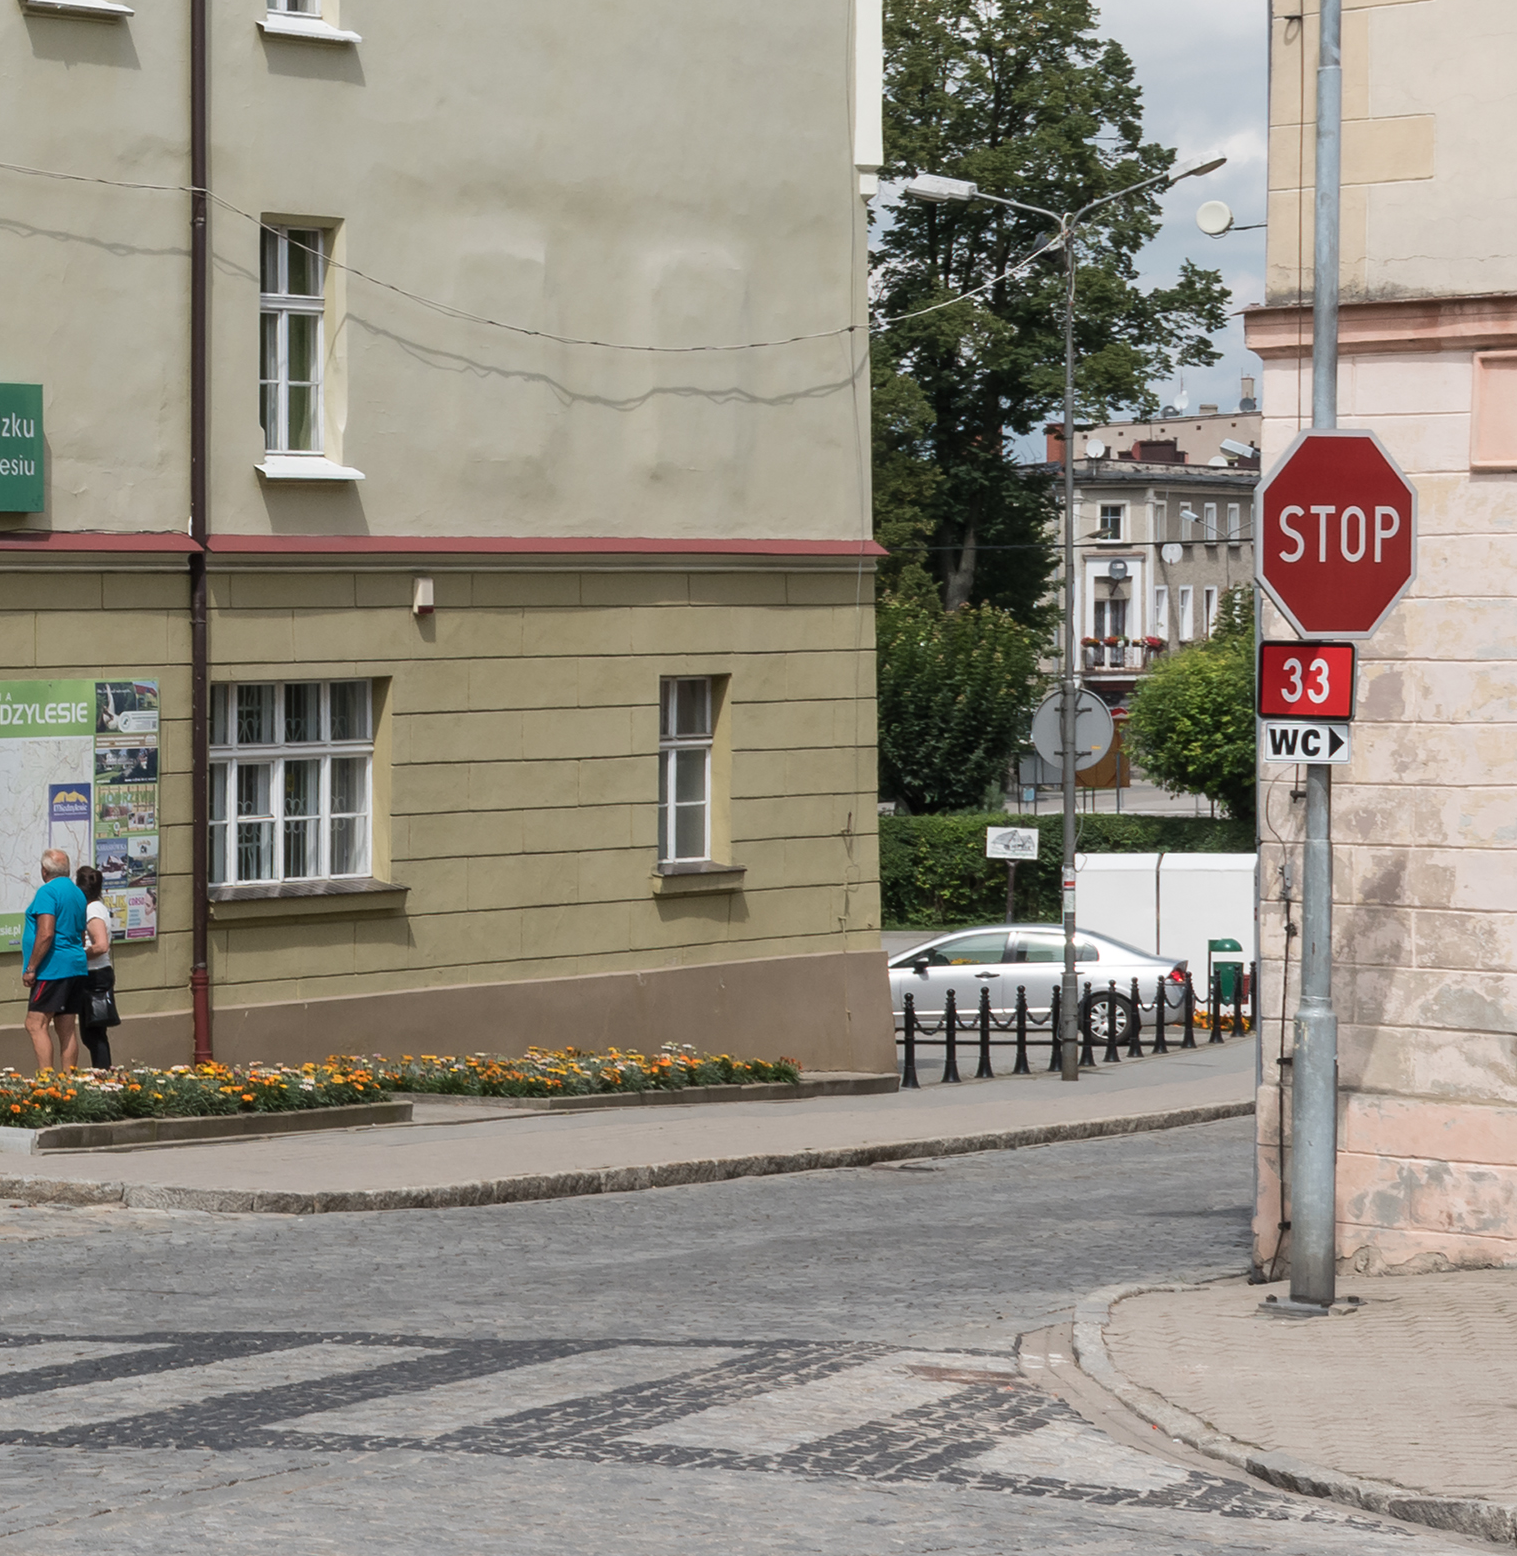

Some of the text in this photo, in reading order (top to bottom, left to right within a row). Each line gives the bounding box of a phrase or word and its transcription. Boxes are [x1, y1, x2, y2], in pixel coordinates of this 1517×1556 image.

[1278, 505, 1400, 563] STOP
[1281, 657, 1330, 704] 33
[1268, 728, 1321, 757] WC
